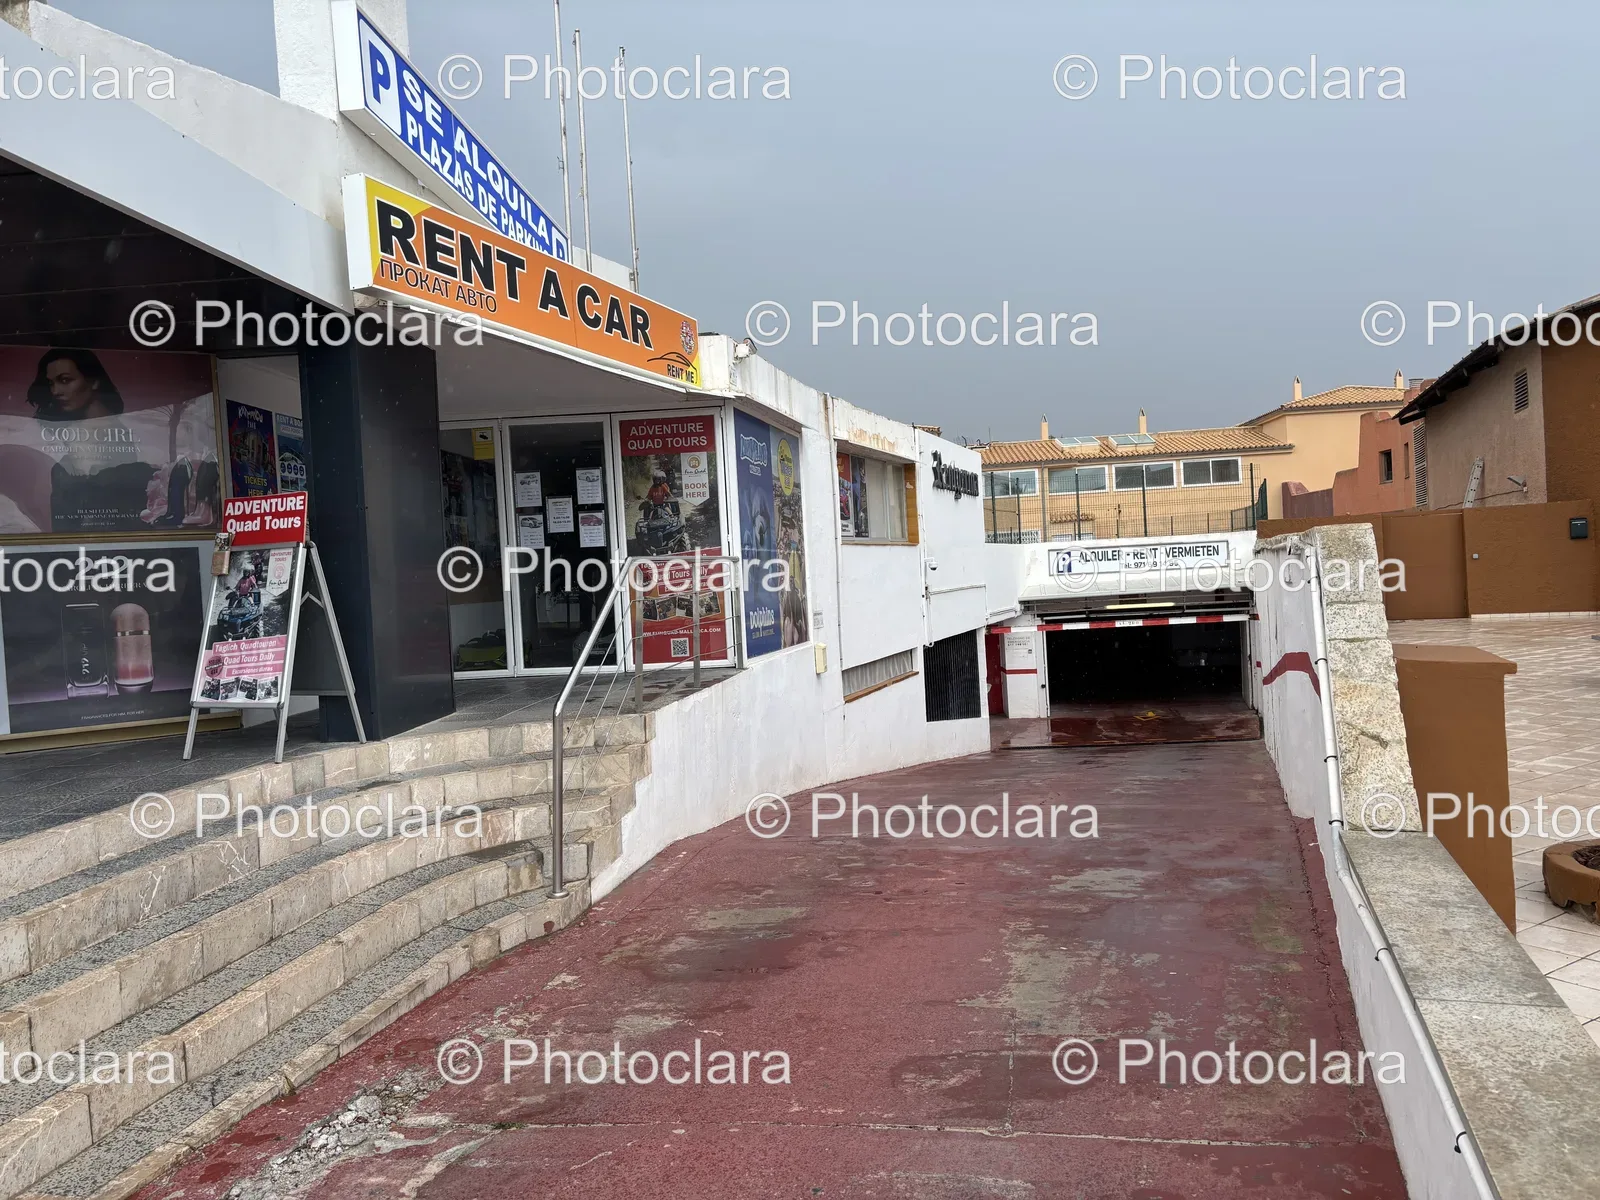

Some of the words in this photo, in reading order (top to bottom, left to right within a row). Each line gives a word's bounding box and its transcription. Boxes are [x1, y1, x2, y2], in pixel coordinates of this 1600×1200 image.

[402, 67, 444, 136] SE
[454, 123, 550, 246] ALQUILA
[406, 110, 476, 203] PLAZAS
[478, 183, 498, 225] DE
[376, 196, 527, 303] RENT
[538, 267, 570, 320] A
[576, 284, 654, 351] CAR
[380, 259, 451, 298] ПРОКАТ
[456, 285, 497, 313] АВТО
[667, 364, 684, 380] RENT
[686, 370, 695, 383] ME
[41, 428, 89, 442] GOOD
[94, 428, 140, 442] GIRL
[630, 423, 704, 436] ADVENTURE
[628, 438, 662, 450] QUAD
[666, 436, 707, 448] TOURS
[244, 476, 267, 486] TICKETS
[225, 496, 305, 516] ADVENTURE
[227, 517, 261, 535] Quad
[264, 515, 301, 530] Tours
[1165, 545, 1219, 558] VERMIETEN
[224, 656, 240, 665] Quad
[241, 655, 258, 663] Tours
[260, 652, 275, 662] Daily
